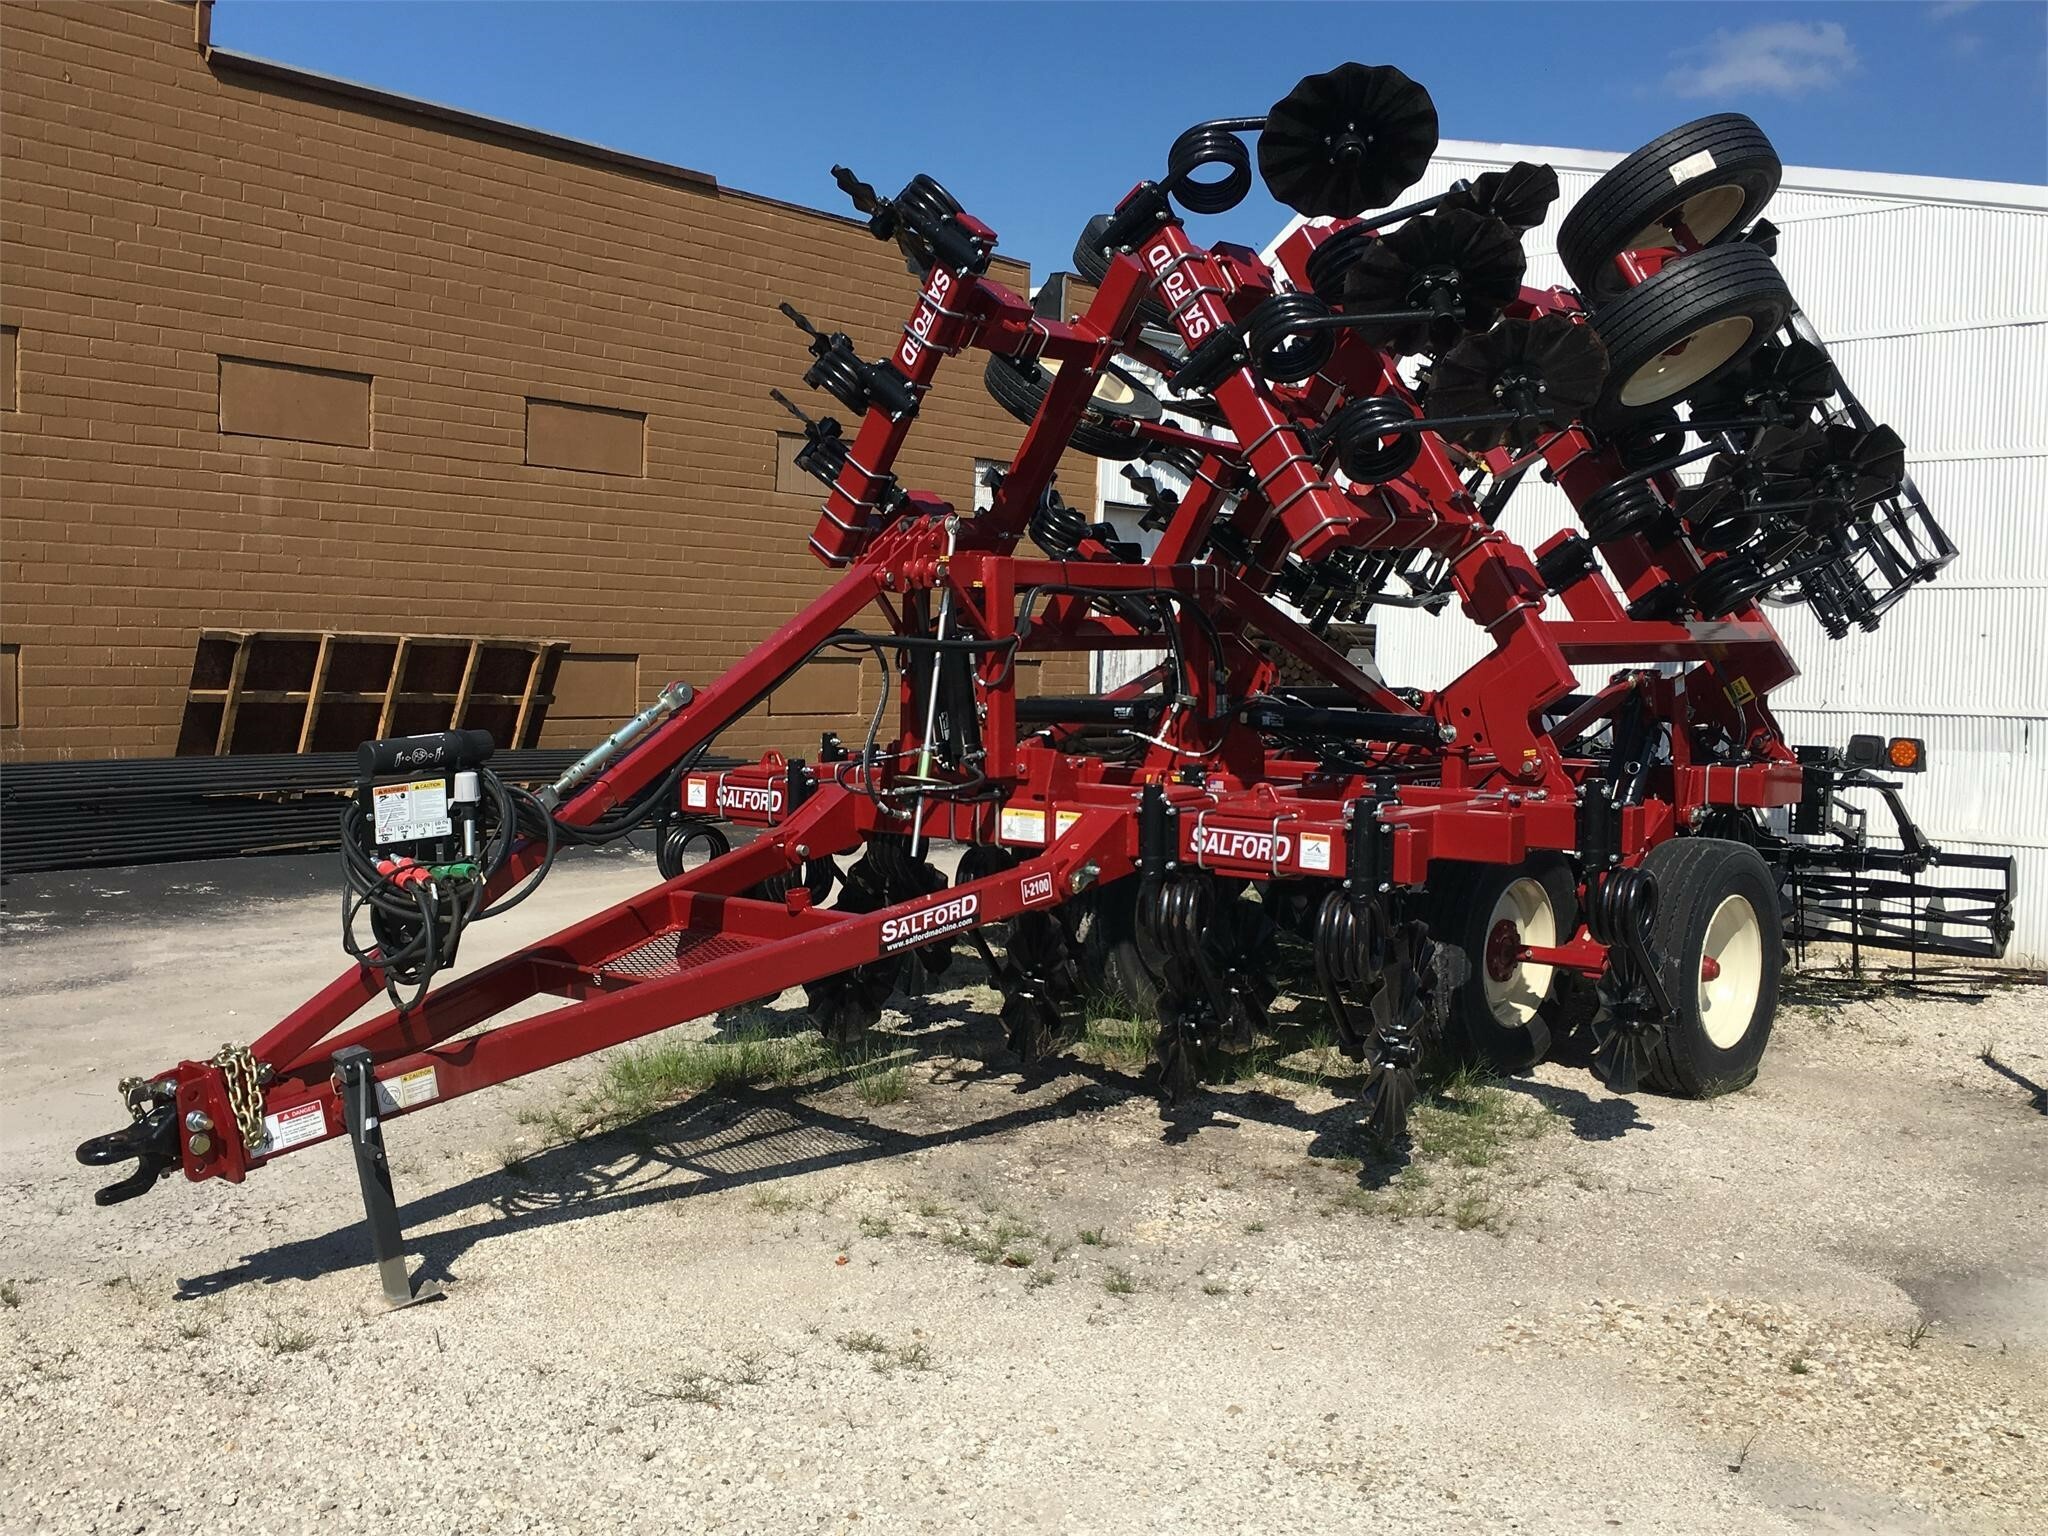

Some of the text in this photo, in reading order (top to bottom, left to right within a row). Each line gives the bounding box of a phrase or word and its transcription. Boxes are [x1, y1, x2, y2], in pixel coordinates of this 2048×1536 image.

[716, 785, 782, 812] SALFORD
[1190, 826, 1291, 862] SALFORD
[1024, 878, 1049, 899] I-2100
[881, 894, 978, 943] SALFORD
[887, 916, 973, 952] www.salfordmachine.com
[291, 1104, 316, 1117] DANGER
